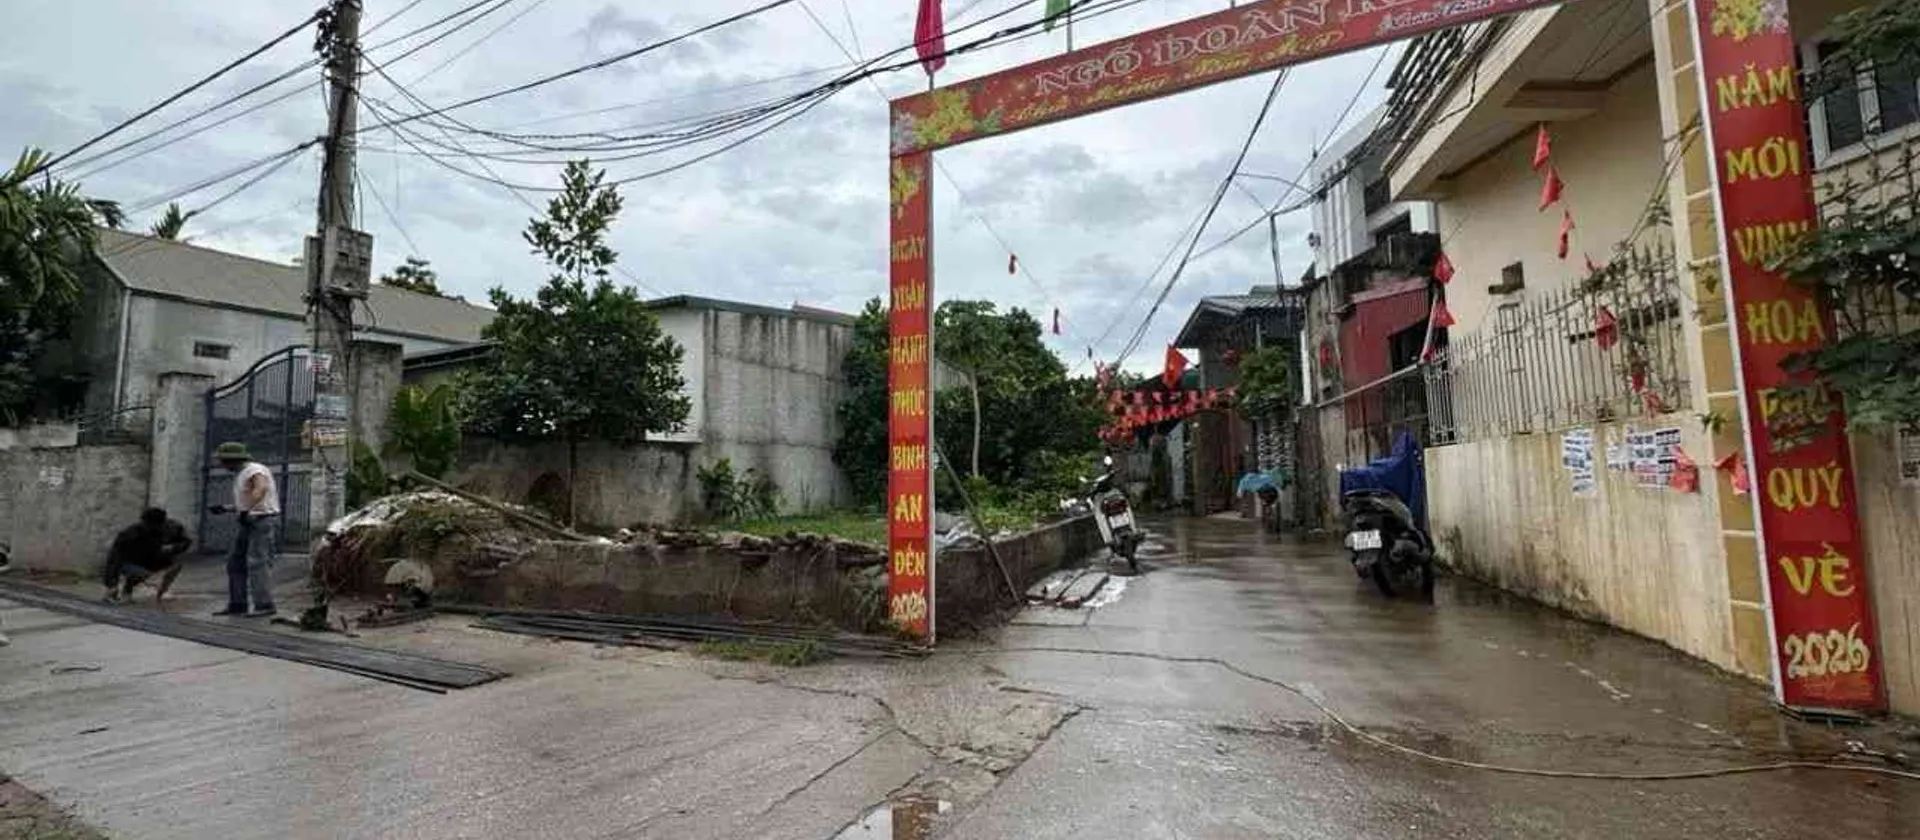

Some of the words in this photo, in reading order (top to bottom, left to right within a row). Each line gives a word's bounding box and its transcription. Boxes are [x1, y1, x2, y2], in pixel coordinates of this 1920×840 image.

[1715, 61, 1796, 112] NĂM
[1725, 137, 1800, 183] MỚI
[1745, 299, 1827, 345] HOA
[892, 384, 925, 416] PHÚC
[893, 440, 925, 470] BÌNH
[894, 494, 923, 522] AN
[1767, 460, 1845, 512] QUÝ
[894, 540, 925, 576] ĐẾN
[1779, 541, 1856, 596] VỀ
[891, 587, 927, 620] 2026
[1784, 622, 1871, 679] 2026
